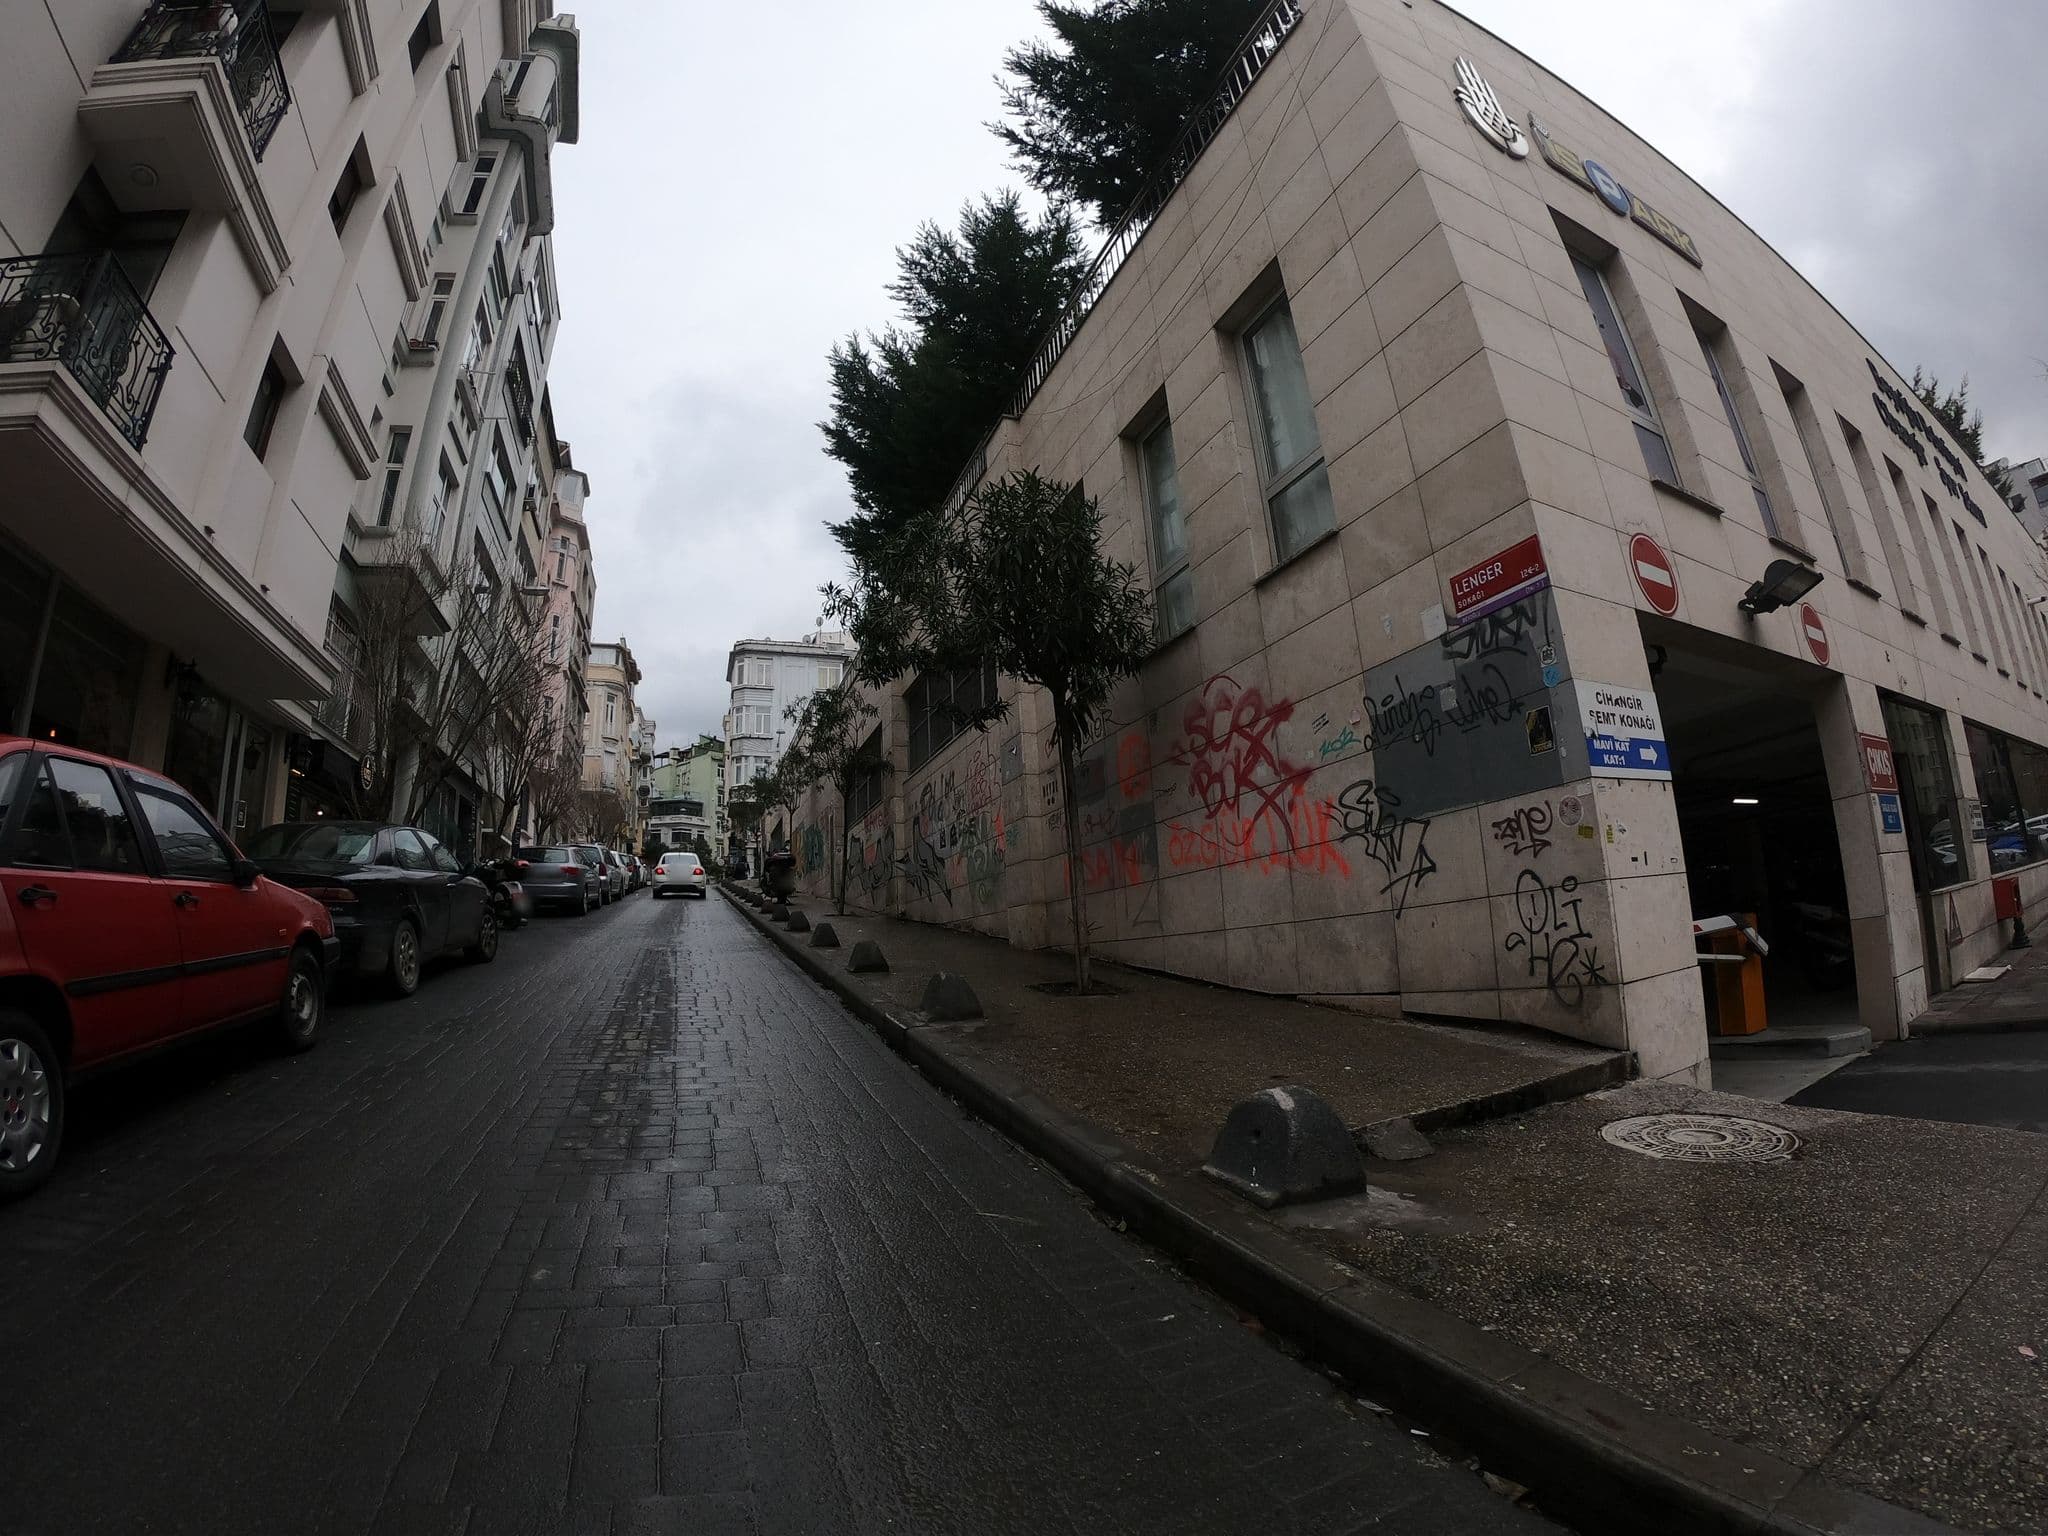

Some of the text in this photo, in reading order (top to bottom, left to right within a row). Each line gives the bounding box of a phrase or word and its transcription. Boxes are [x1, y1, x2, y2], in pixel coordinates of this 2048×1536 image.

[1455, 561, 1504, 596] LENGER
[1595, 689, 1644, 711] CİHANGİR
[1619, 714, 1656, 731] KONAĞI
[1593, 738, 1631, 752] MAVİ KAT
